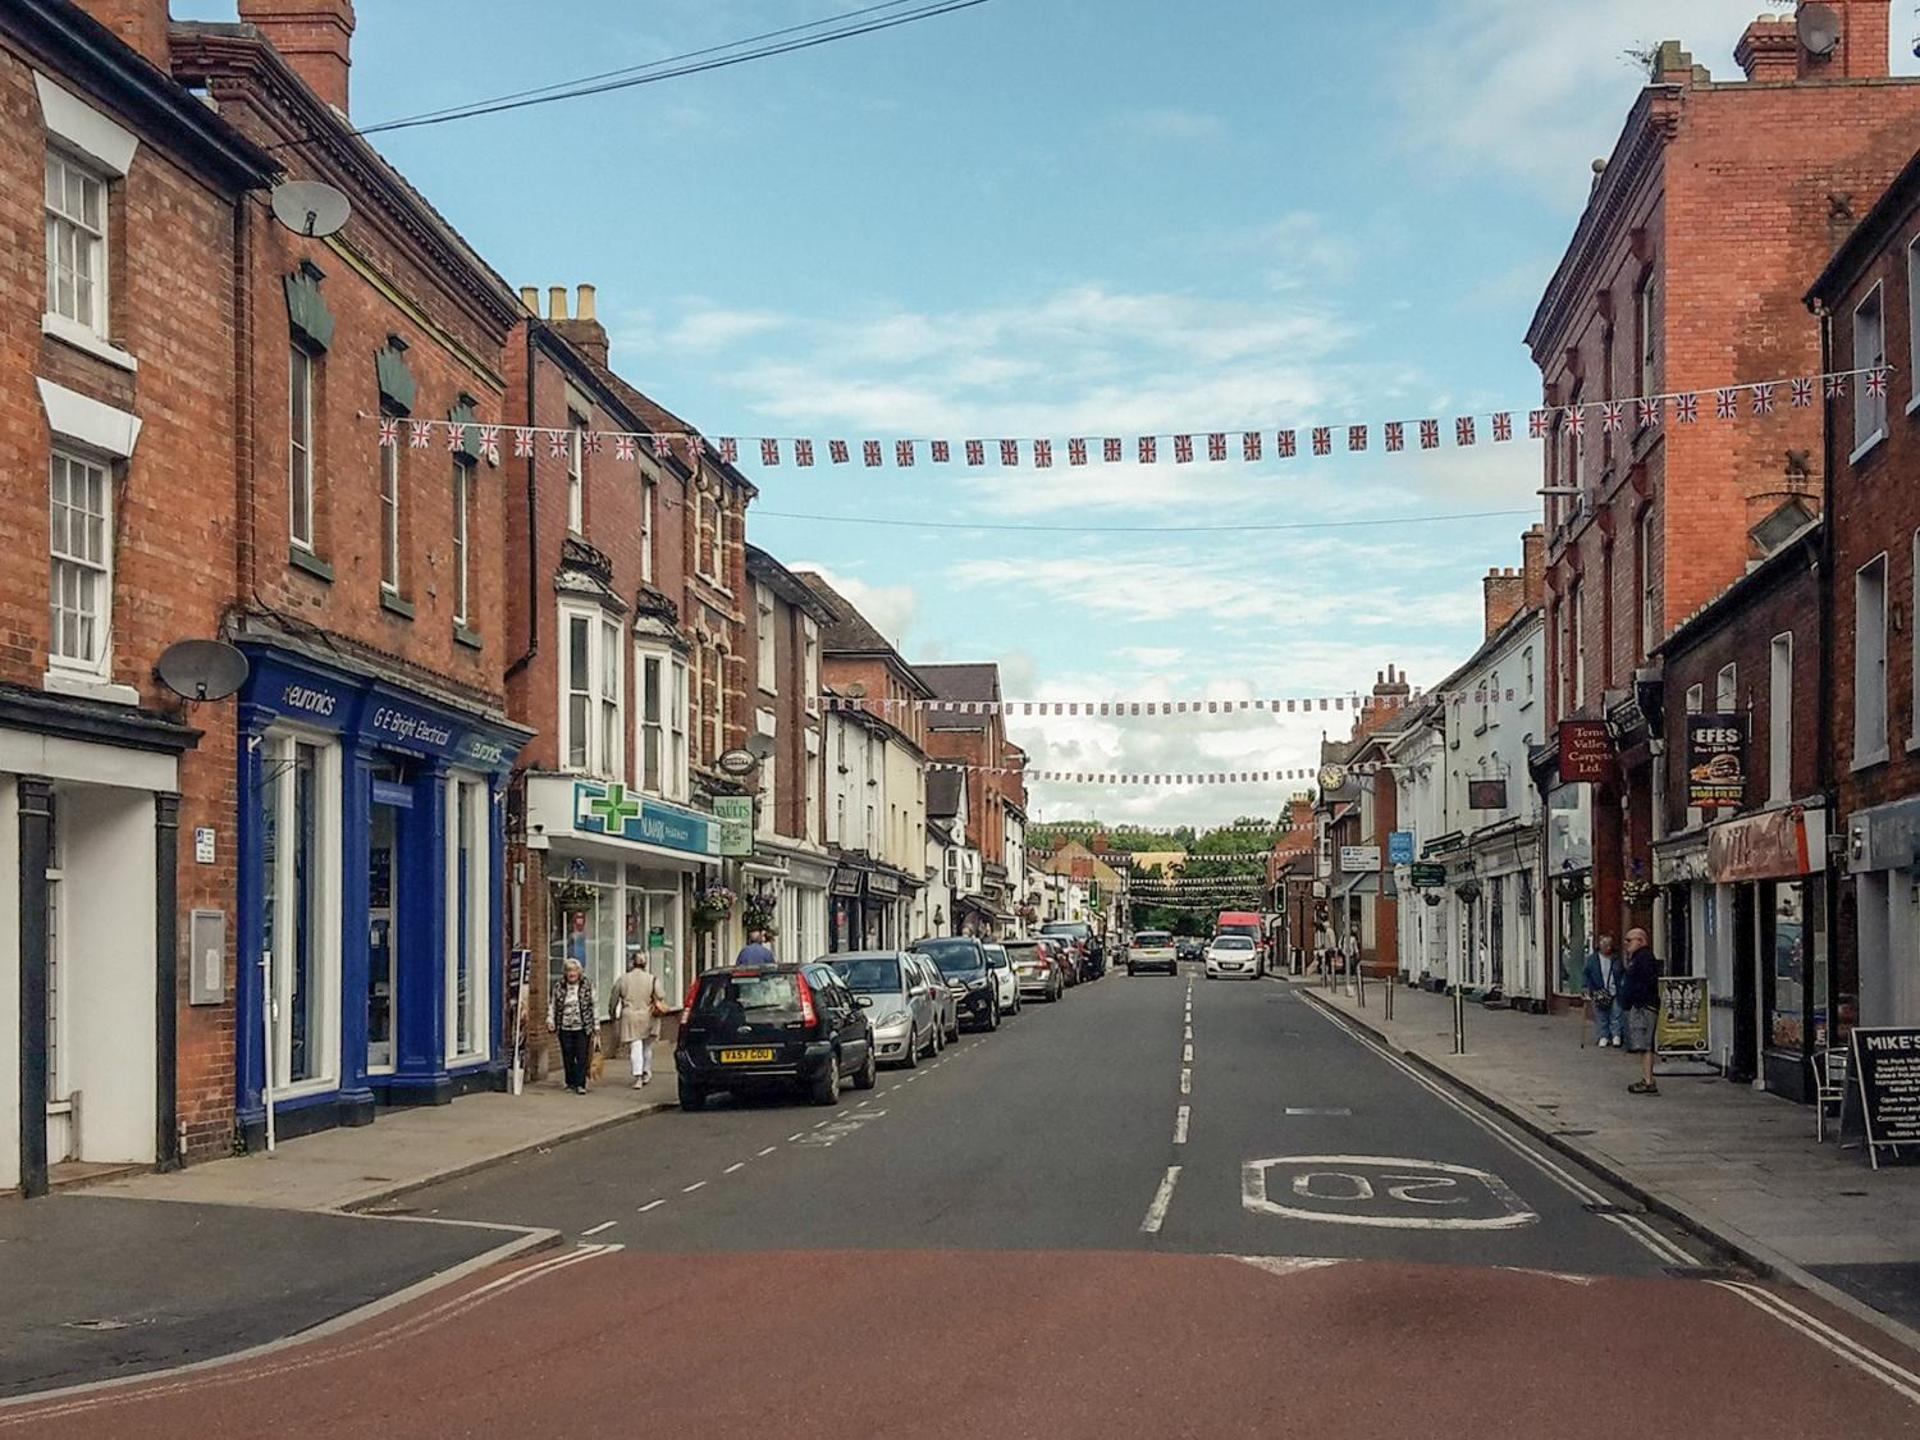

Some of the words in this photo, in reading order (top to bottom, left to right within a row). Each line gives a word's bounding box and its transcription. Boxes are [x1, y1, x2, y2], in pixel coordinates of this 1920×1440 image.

[289, 686, 336, 716] euronics
[374, 707, 385, 727] G
[382, 710, 393, 729] E
[390, 712, 417, 740] Bright
[415, 720, 452, 746] Electrical
[1696, 728, 1738, 743] EFES
[1573, 739, 1607, 749] Valley
[471, 742, 502, 763] euronics
[1568, 751, 1613, 762] Carpets
[714, 804, 750, 818] VAULTS
[1866, 1035, 1920, 1051] MIKE'S
[1293, 1172, 1470, 1204] 20
